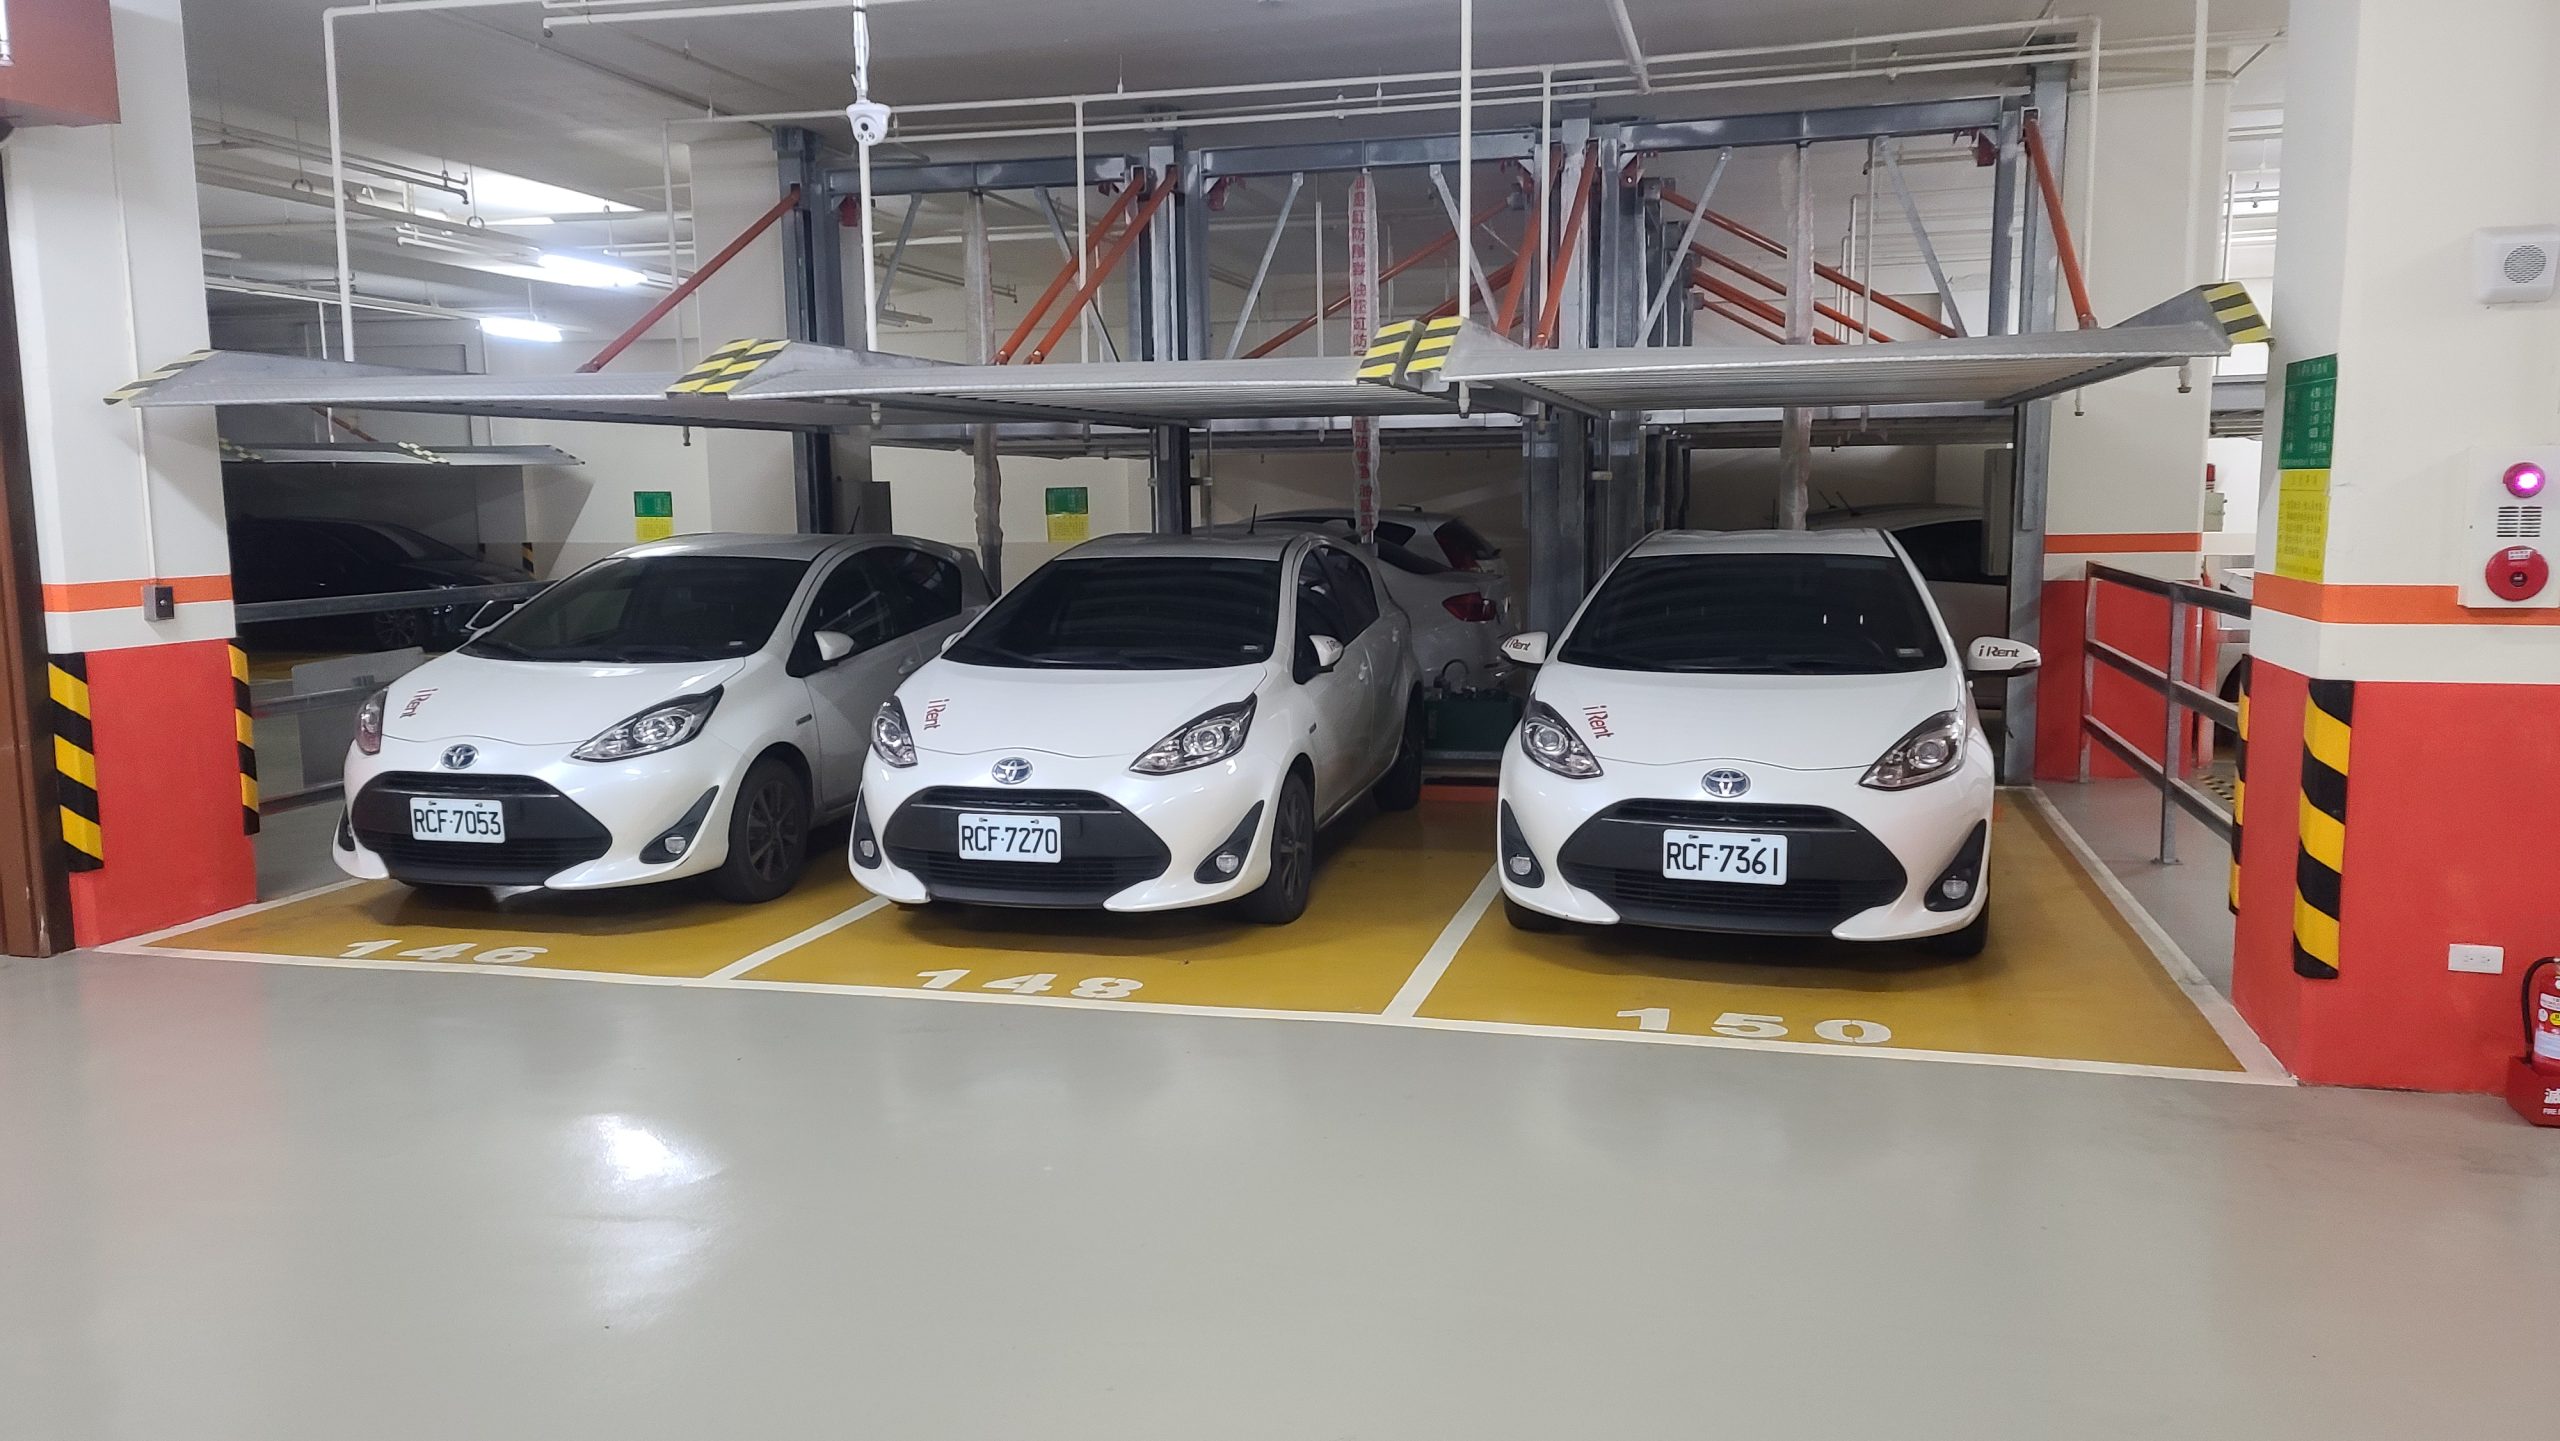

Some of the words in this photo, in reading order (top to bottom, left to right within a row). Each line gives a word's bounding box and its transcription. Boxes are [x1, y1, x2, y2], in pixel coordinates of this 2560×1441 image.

[338, 939, 549, 963] 146
[916, 968, 1144, 999] 148
[1616, 1007, 1893, 1043] 150
